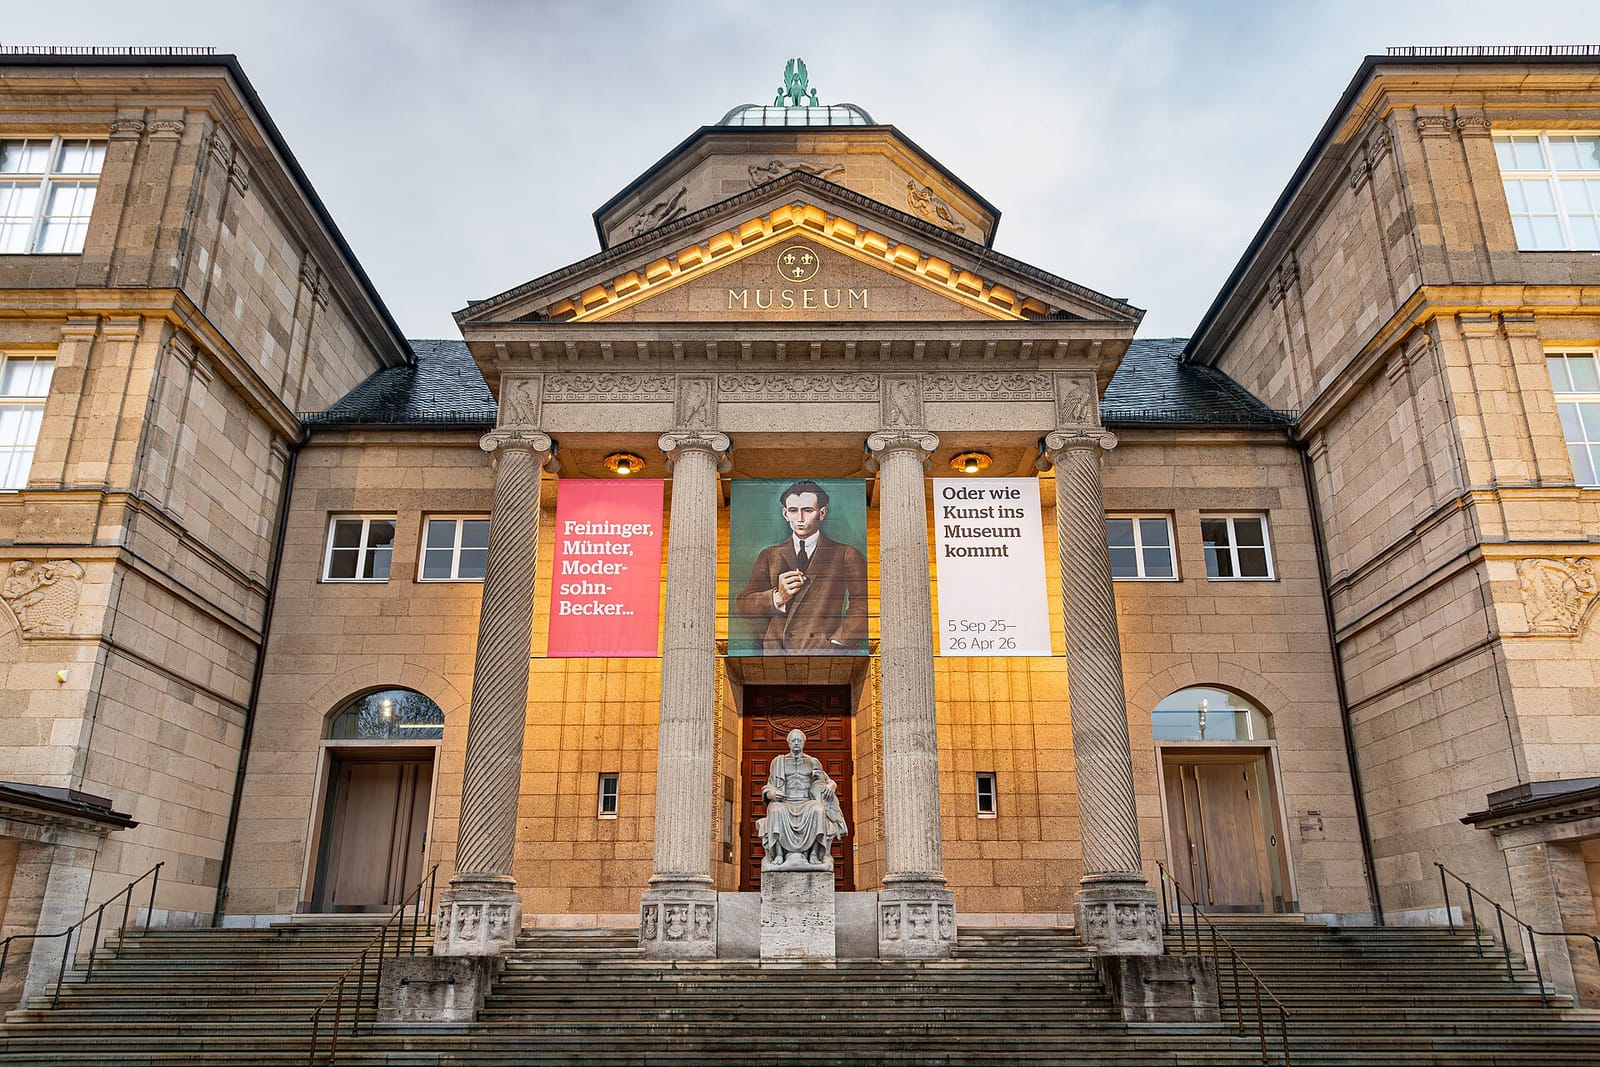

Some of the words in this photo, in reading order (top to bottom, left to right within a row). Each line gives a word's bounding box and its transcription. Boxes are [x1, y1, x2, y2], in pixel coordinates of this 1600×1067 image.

[728, 289, 869, 310] MUSEUM
[942, 486, 986, 500] Oder
[989, 486, 1021, 500] wie
[943, 505, 995, 519] Kunst
[998, 505, 1025, 519] ins
[564, 520, 654, 538] Feininger,
[944, 524, 1021, 538] Museum
[562, 540, 634, 556] Münter,
[945, 544, 1009, 558] kommt
[561, 560, 628, 575] Moder-
[559, 580, 612, 595] sohn-
[558, 600, 634, 616] Becker...
[948, 619, 956, 632] 5
[960, 619, 986, 634] Sep
[949, 637, 967, 650] 26
[970, 637, 995, 652] Apr
[998, 637, 1016, 650] 26
